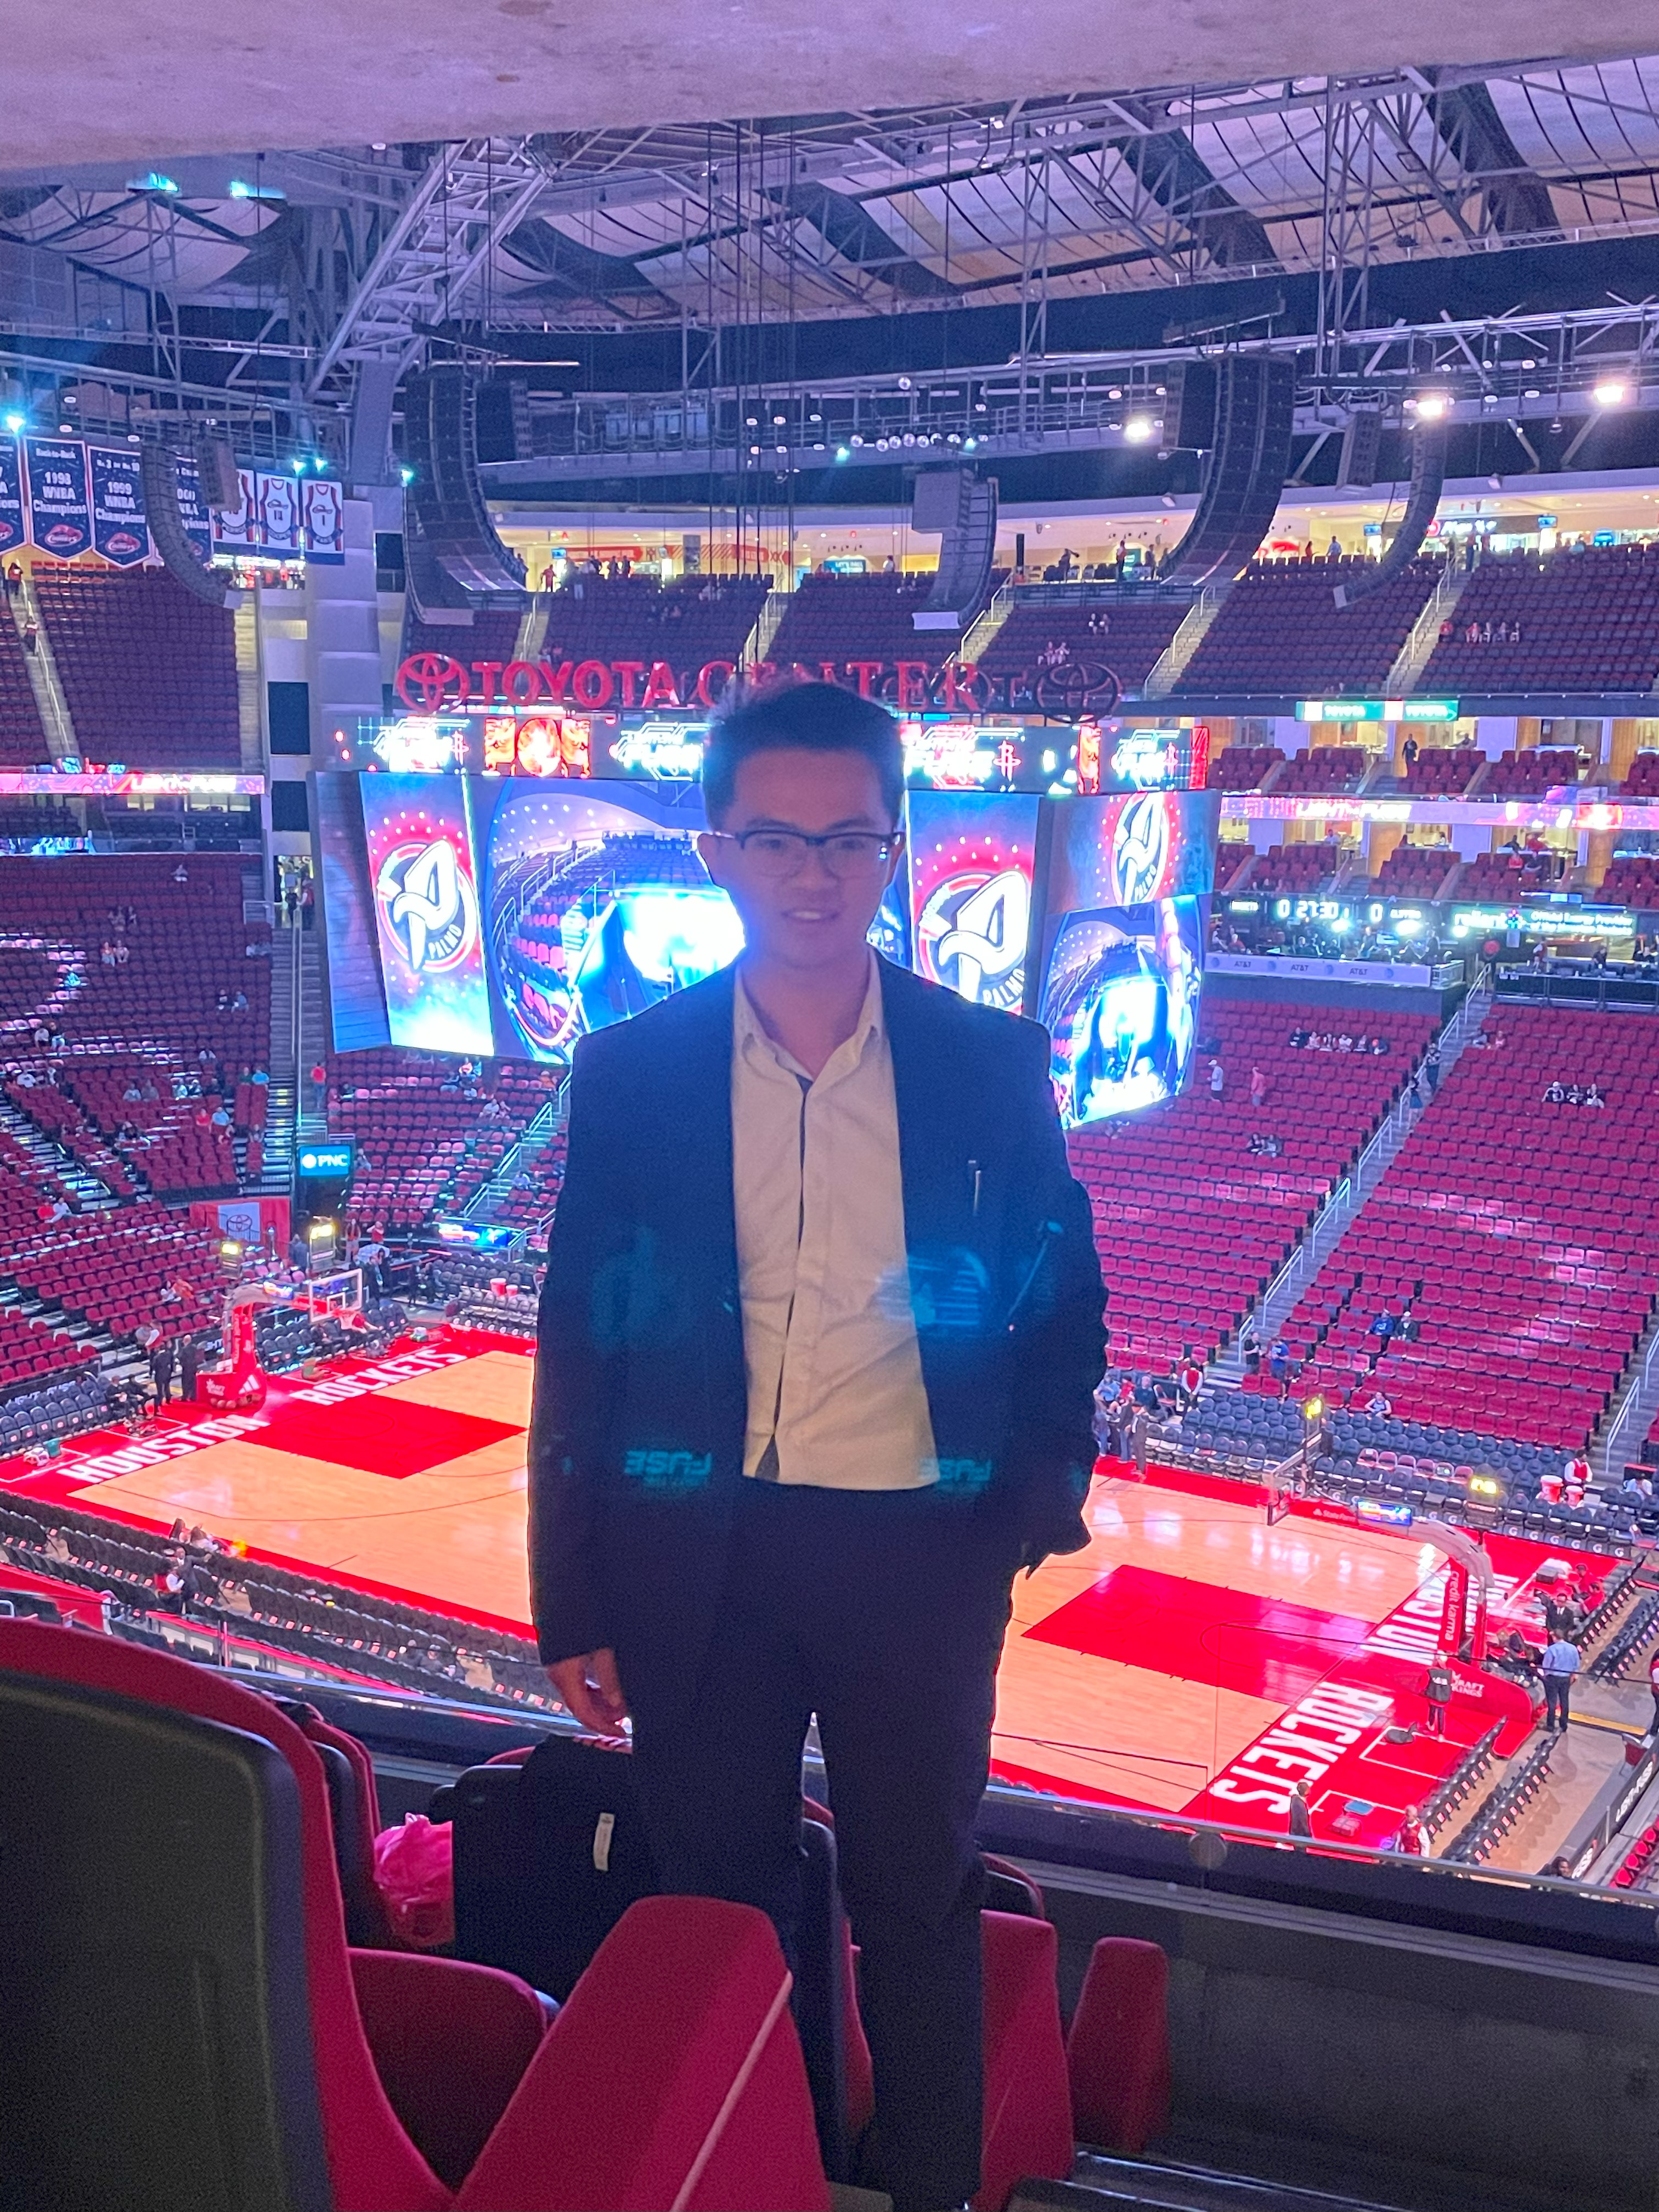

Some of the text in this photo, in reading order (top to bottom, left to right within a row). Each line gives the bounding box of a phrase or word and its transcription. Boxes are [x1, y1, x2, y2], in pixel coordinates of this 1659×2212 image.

[42, 486, 76, 500] WNBA
[108, 482, 132, 494] 1999
[33, 499, 87, 517] Champions
[104, 495, 136, 509] WNBA
[95, 507, 146, 524] Champions
[471, 661, 680, 708] TOYOTA
[1278, 899, 1290, 918] 0
[1371, 904, 1383, 922] 0
[1455, 910, 1509, 929] reliant
[428, 924, 462, 960] PALMO
[983, 968, 1025, 1008] PALMO
[318, 1155, 348, 1167] PNC
[289, 1349, 467, 1406] ROCKETS
[57, 1414, 271, 1484] HOUSTON
[1509, 1527, 1517, 1536] G
[1530, 1532, 1538, 1540] G
[1551, 1536, 1560, 1544] G
[1572, 1540, 1581, 1549] G
[1593, 1544, 1602, 1553] G
[1615, 1548, 1624, 1557] G
[1445, 1571, 1460, 1641] credit karma
[1209, 1681, 1395, 1814] ROCKETS
